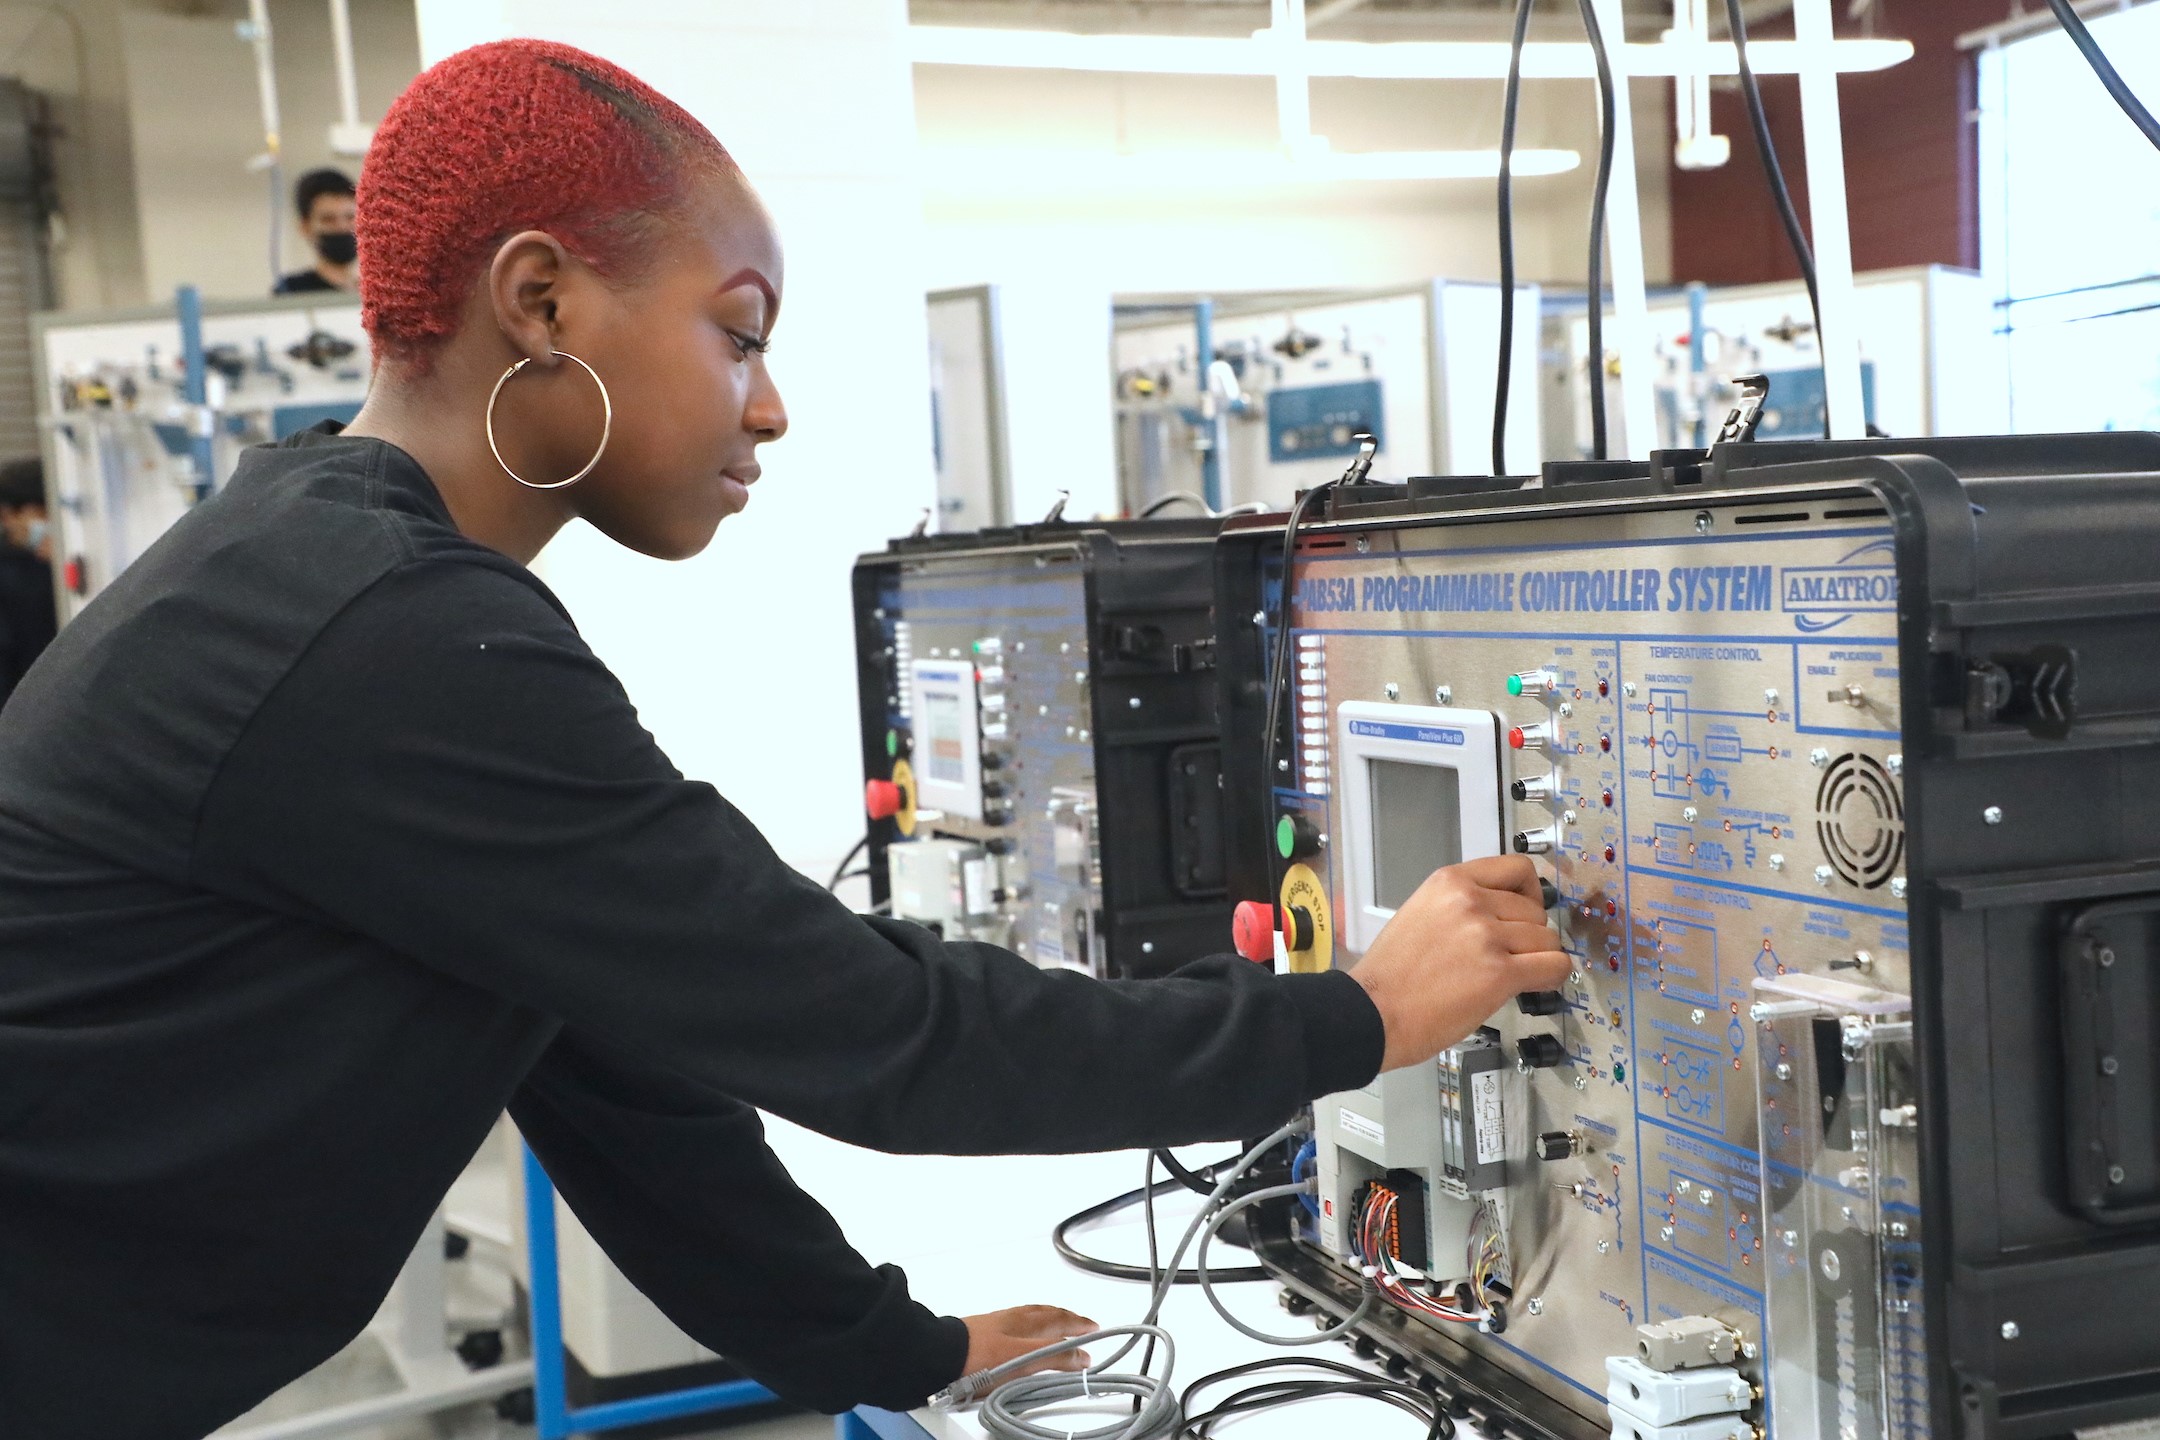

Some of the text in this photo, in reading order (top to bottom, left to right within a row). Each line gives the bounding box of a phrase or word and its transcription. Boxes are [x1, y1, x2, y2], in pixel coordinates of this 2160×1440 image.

[1362, 572, 1513, 612] PROGRAMMABLE
[1519, 568, 1660, 612] CONTROLLER
[1666, 565, 1772, 612] SYSTEM
[1650, 646, 1762, 661] TEMPERATURE CONTROL
[1358, 724, 1385, 736] Allen-Bradley
[1418, 730, 1463, 744] PanelView Plus 600
[1313, 896, 1325, 932] STOP
[1574, 1113, 1617, 1137] POTENTIOMETER
